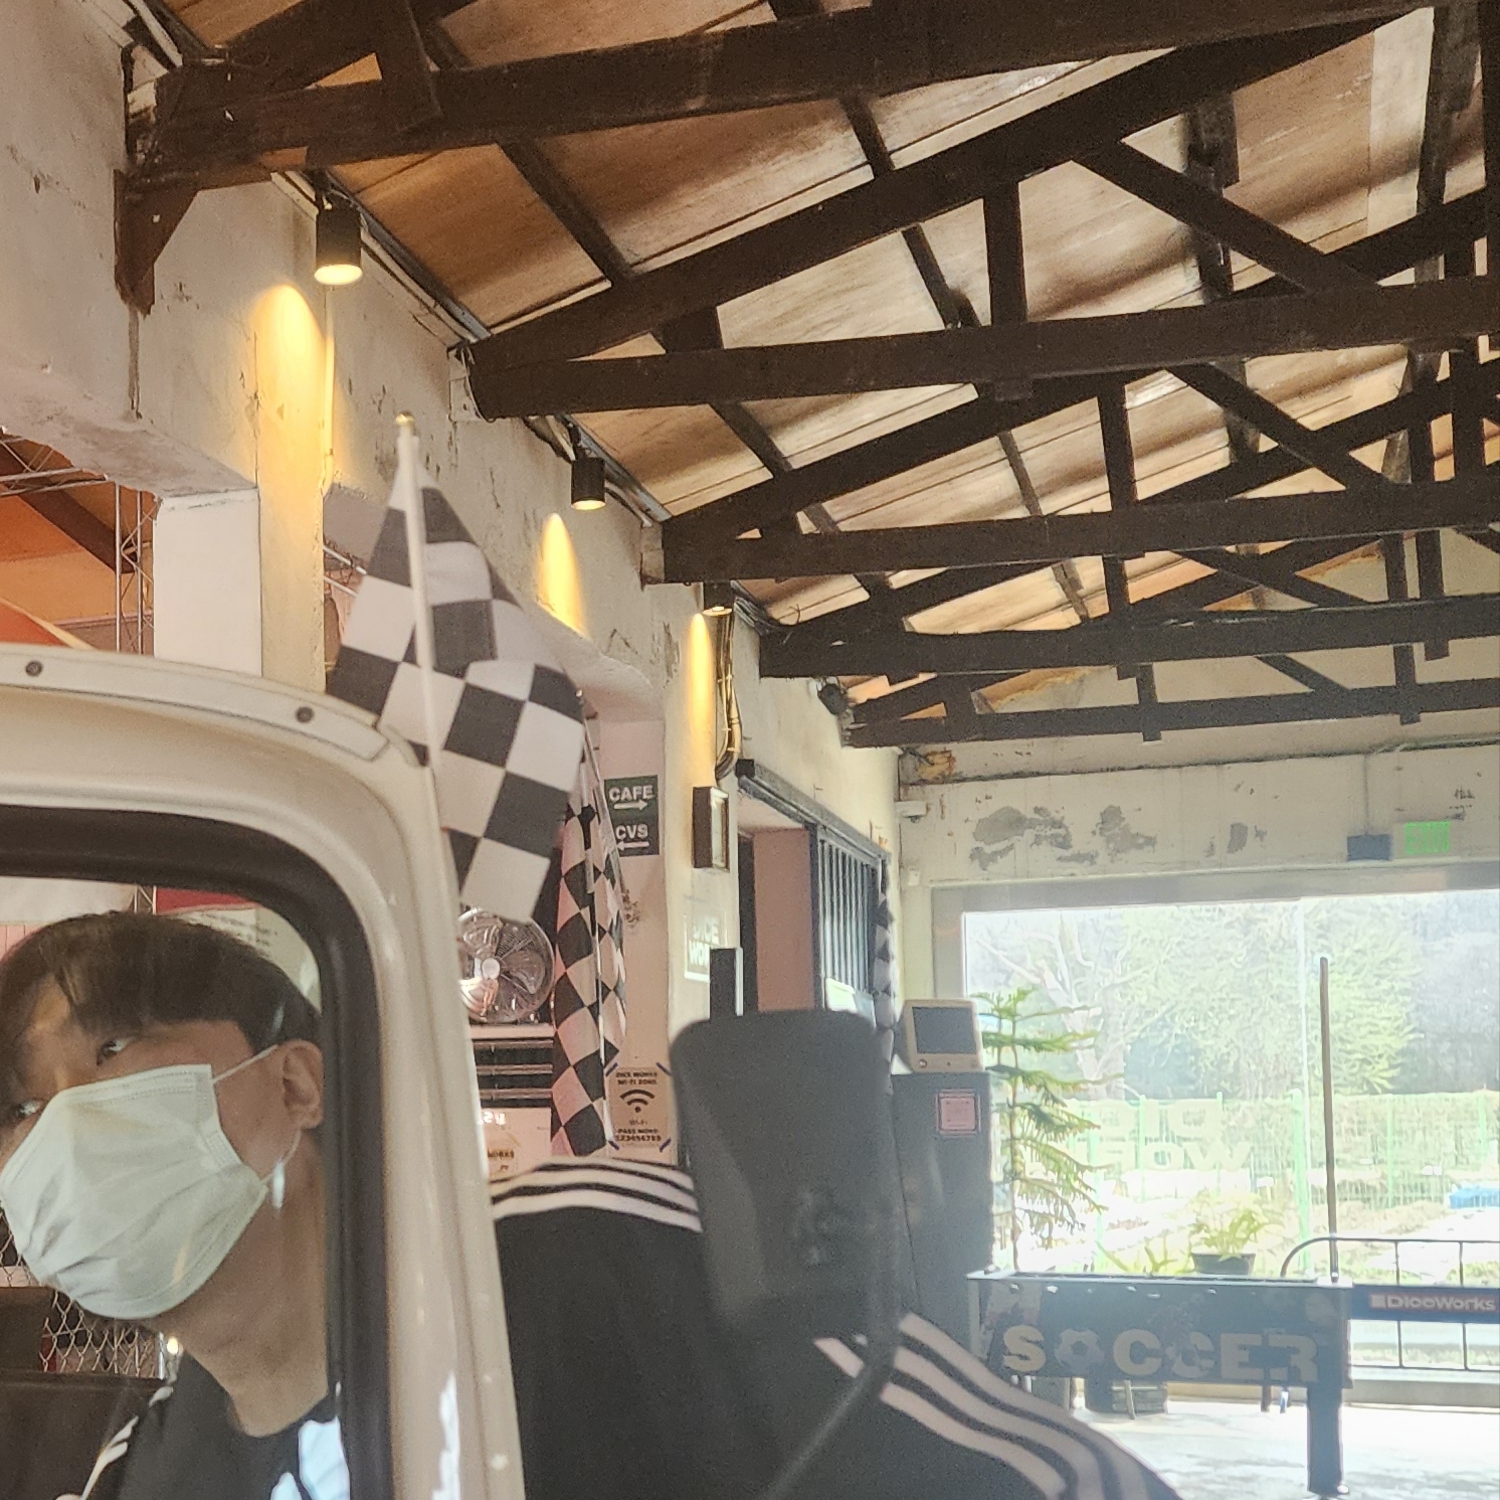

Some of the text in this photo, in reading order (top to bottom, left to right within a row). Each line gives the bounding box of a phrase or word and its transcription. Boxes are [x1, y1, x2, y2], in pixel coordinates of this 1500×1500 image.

[608, 784, 654, 801] CAFE
[615, 823, 649, 840] CVS
[1003, 1325, 1319, 1382] SOCCER
